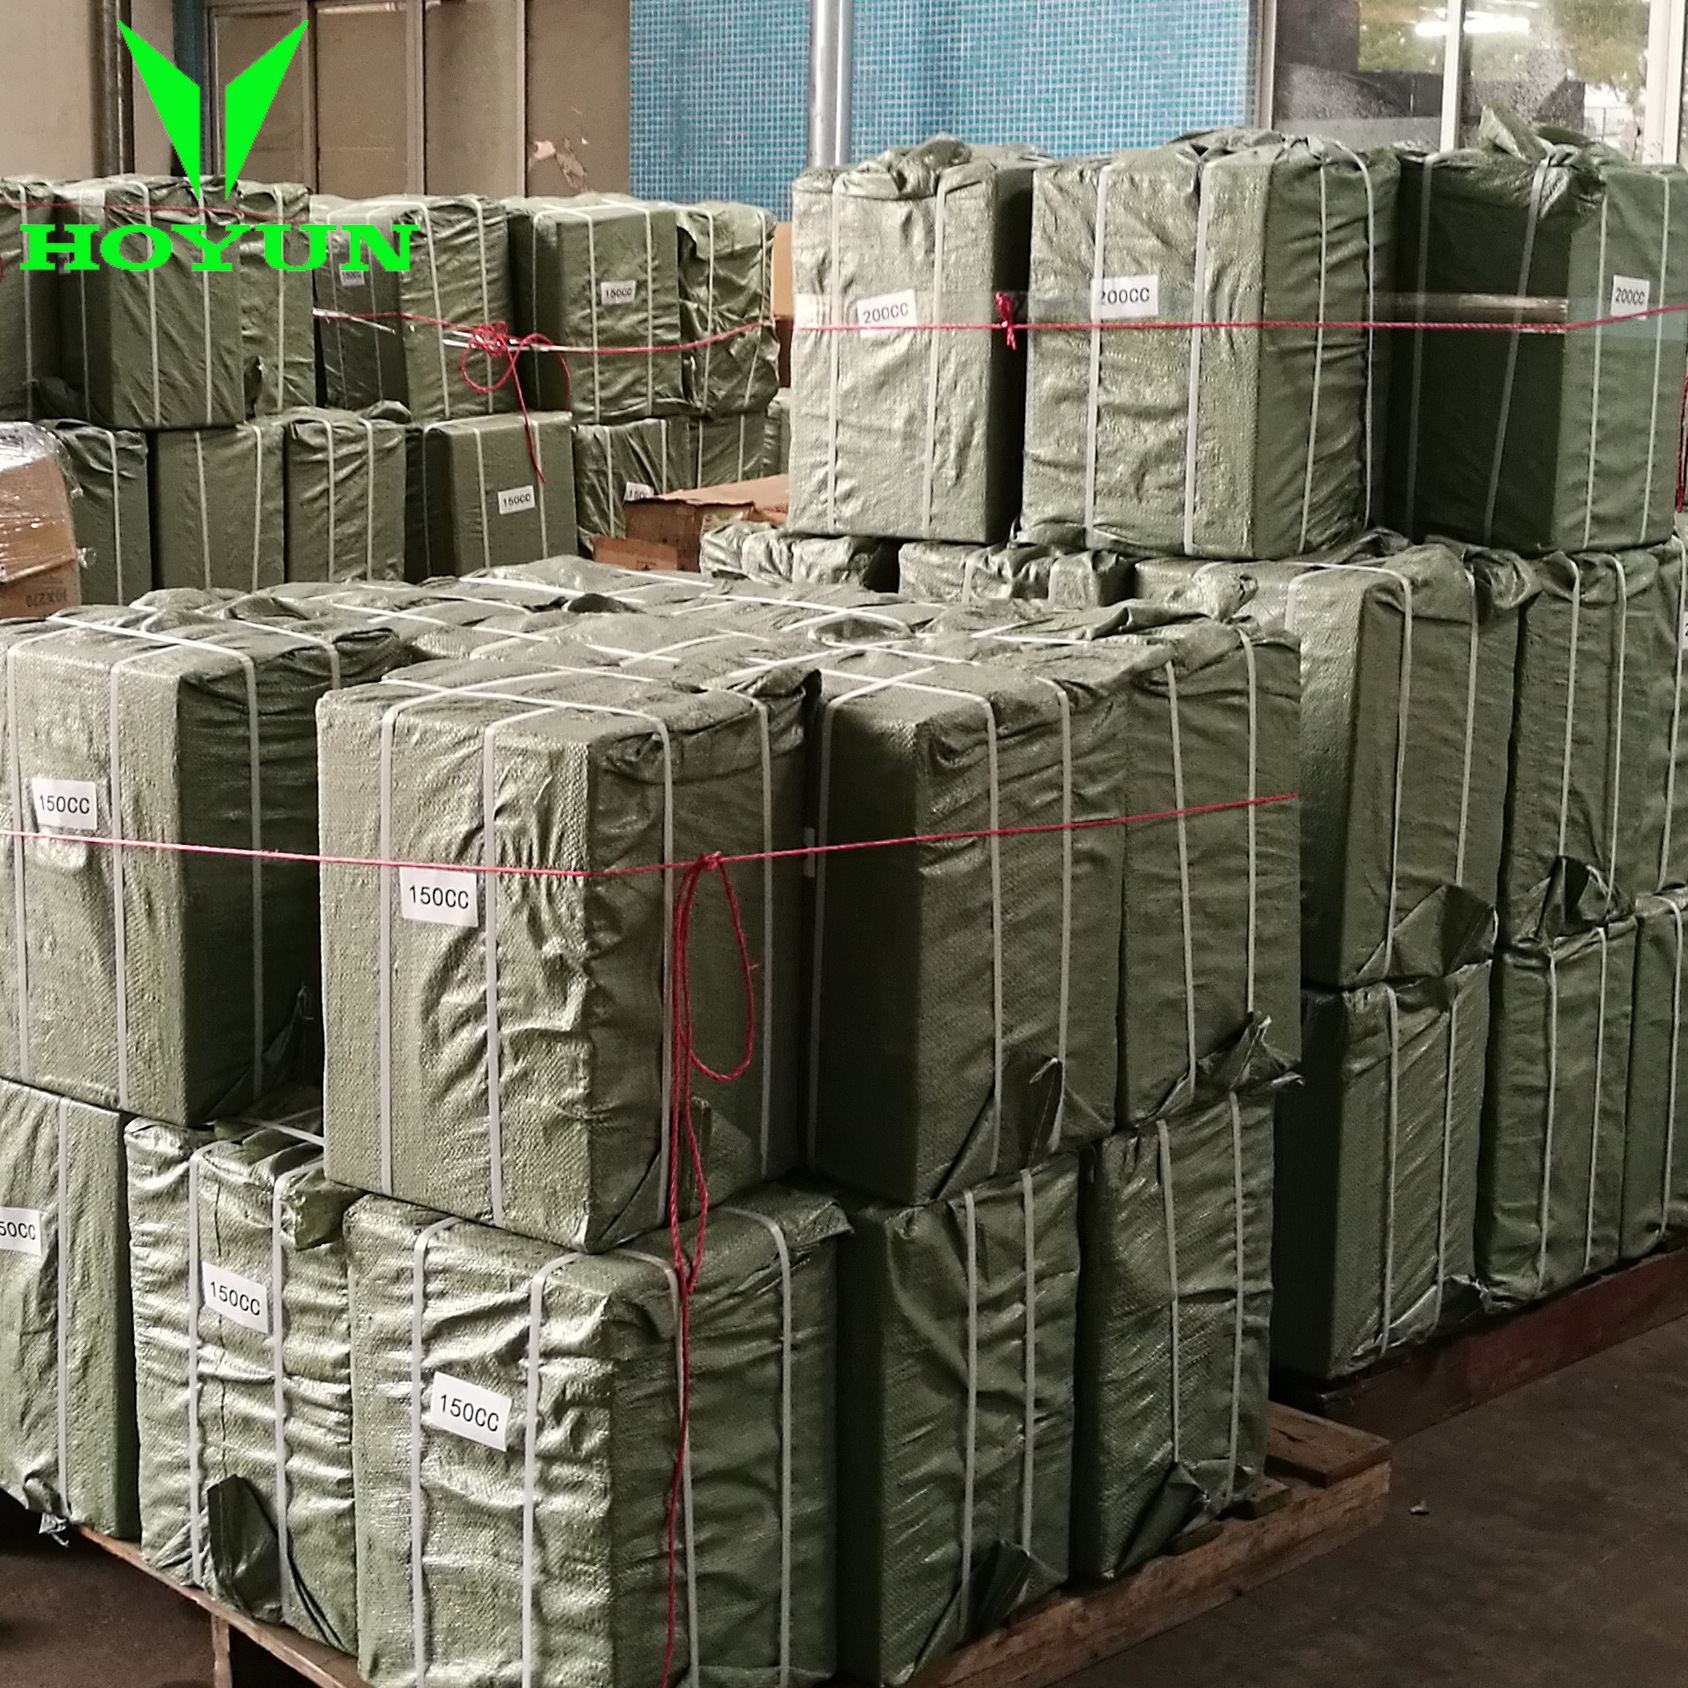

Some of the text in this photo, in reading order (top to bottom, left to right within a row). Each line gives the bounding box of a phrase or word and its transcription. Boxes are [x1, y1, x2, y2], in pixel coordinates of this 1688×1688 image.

[1616, 287, 1646, 306] 200CC
[863, 303, 909, 324] 200CC
[503, 493, 531, 506] 150CC
[40, 794, 91, 814] 150CC
[409, 885, 470, 910] 150CC
[0, 1221, 36, 1240] 50CC
[209, 1280, 261, 1316] 150CC
[439, 1394, 500, 1432] 150CC
